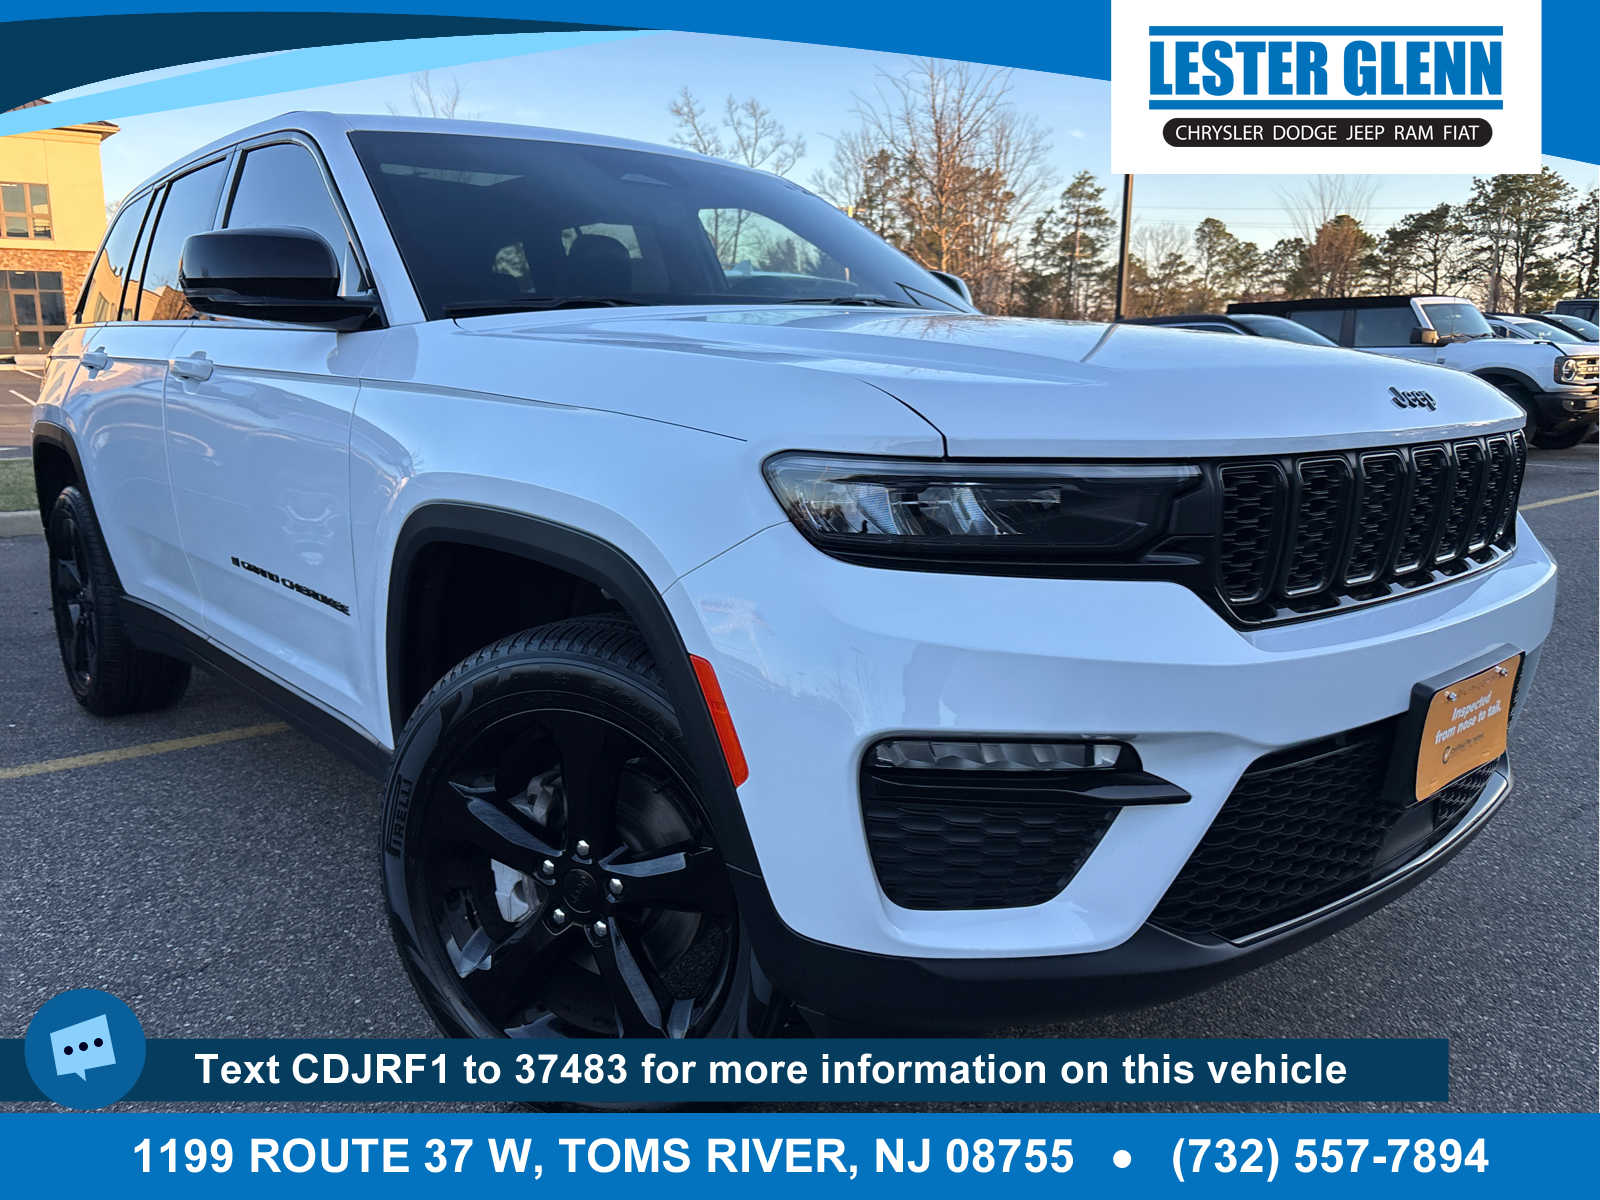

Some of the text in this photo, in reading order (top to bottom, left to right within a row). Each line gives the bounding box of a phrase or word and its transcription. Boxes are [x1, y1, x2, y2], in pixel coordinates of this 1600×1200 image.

[1388, 386, 1437, 412] Jeep
[240, 561, 351, 616] GRAND CHEROKEE
[1452, 690, 1493, 721] Inspected
[1434, 726, 1457, 745] from
[1456, 715, 1478, 734] nose
[1477, 709, 1488, 723] to
